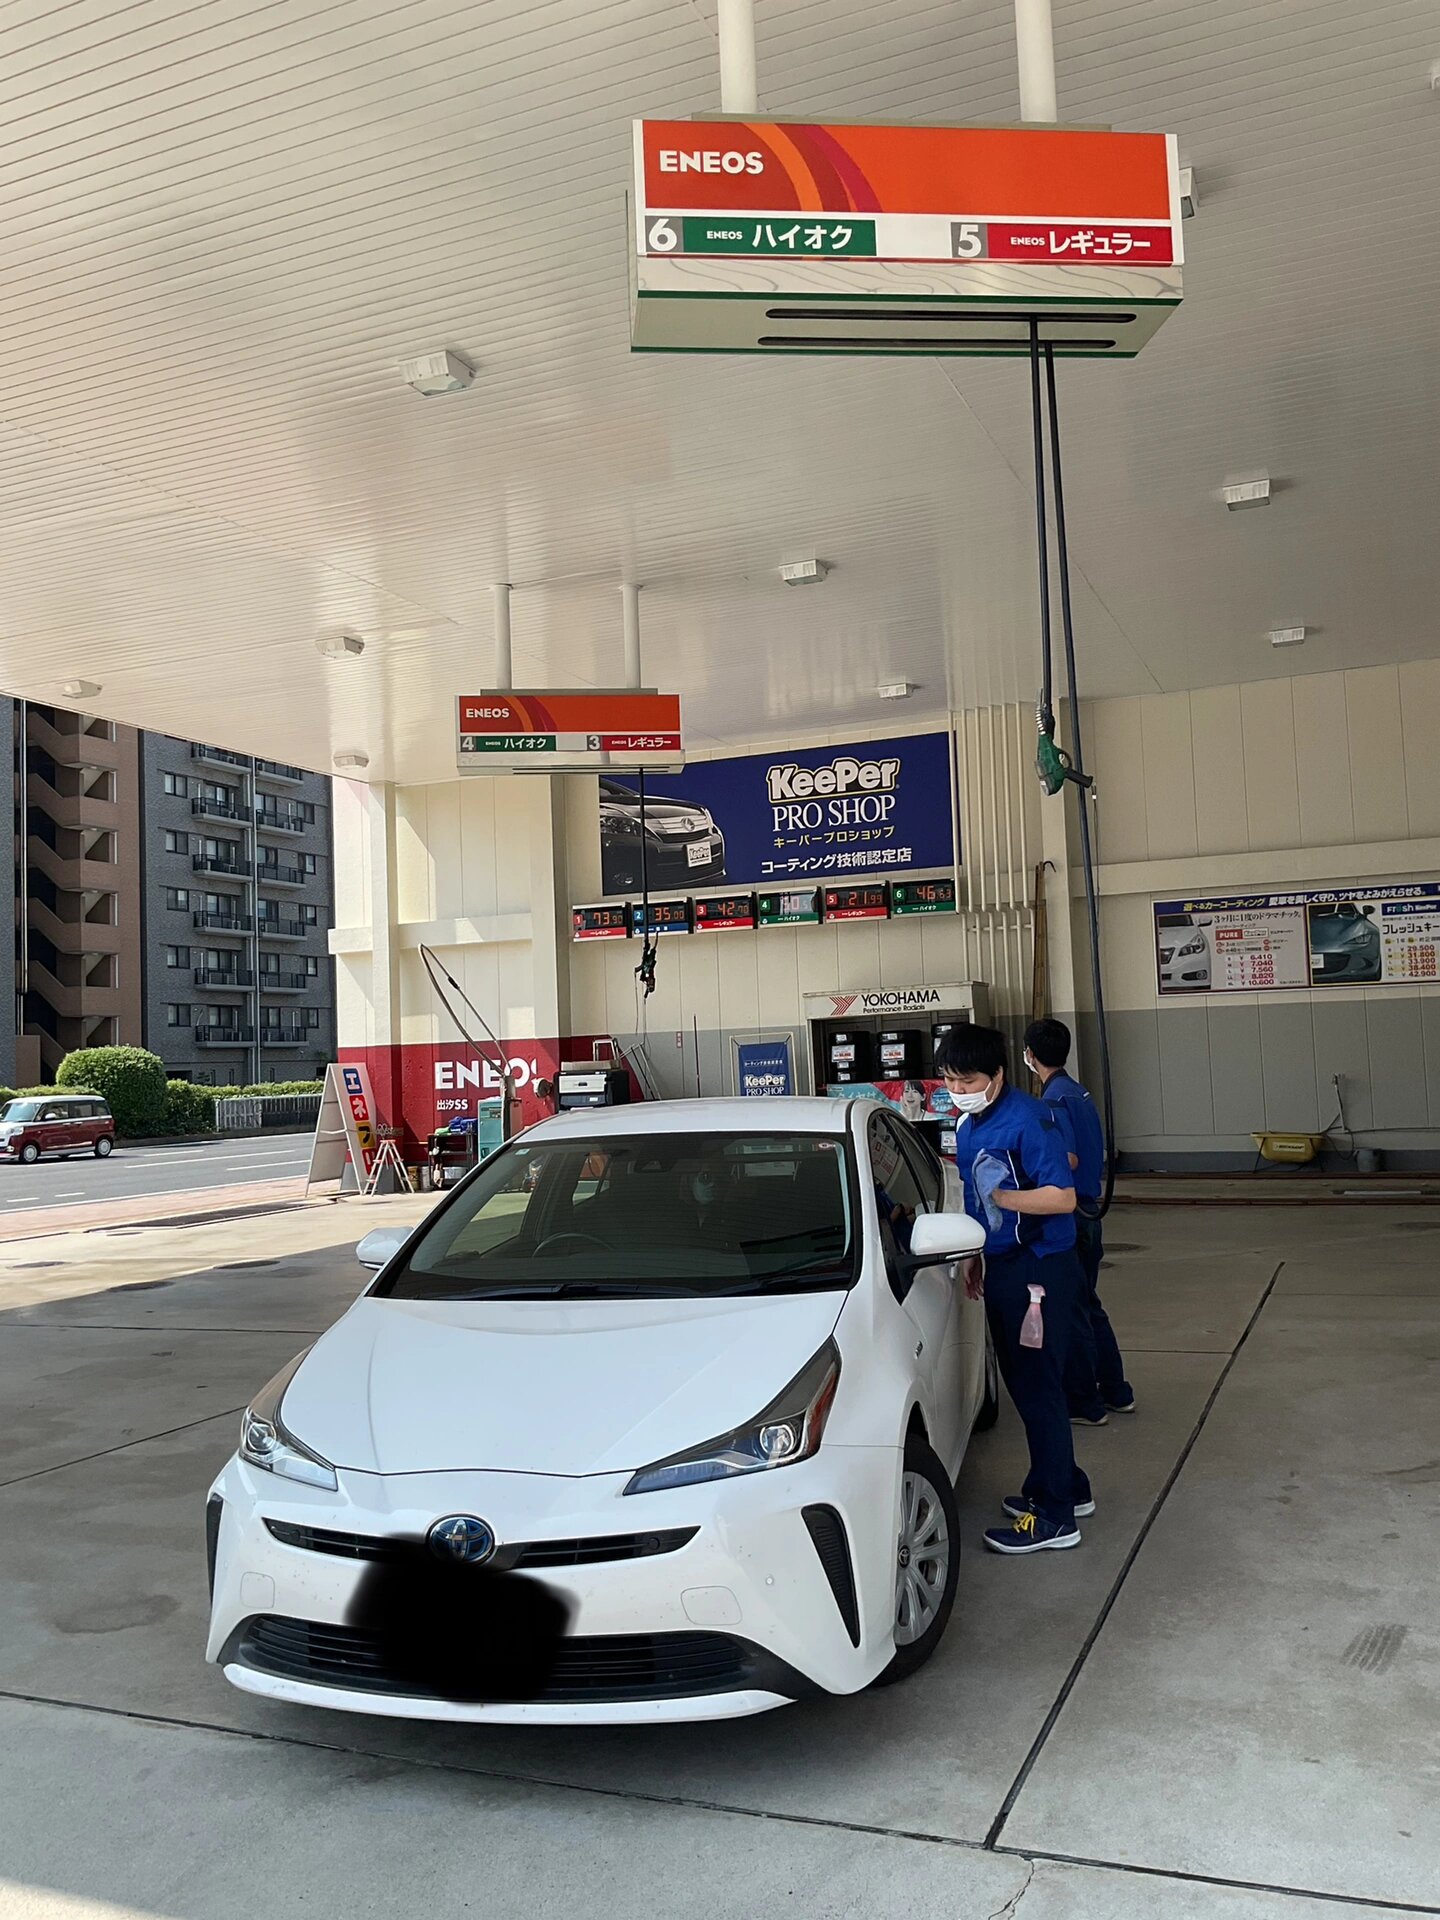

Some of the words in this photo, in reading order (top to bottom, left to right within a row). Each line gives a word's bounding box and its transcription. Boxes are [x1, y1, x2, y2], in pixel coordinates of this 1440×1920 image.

[660, 150, 764, 174] ENEOS
[649, 218, 677, 251] 6
[706, 230, 743, 240] ENEOS
[752, 224, 853, 249] ハイオク
[958, 224, 982, 258] 5
[1010, 236, 1046, 246] ENEOS
[1049, 230, 1151, 255] レギュラー
[466, 708, 510, 718] ENEOS
[462, 736, 474, 750] 4
[504, 737, 547, 749] ハイオク
[589, 735, 600, 750] 3
[628, 736, 672, 748] レギュラー
[768, 759, 898, 801] KeePer
[772, 802, 823, 832] PRO
[828, 795, 896, 826] SHOP
[773, 825, 895, 848] キーパープロショップ
[761, 847, 912, 874] コーティング技術認定店
[830, 895, 834, 903] 5
[896, 890, 902, 898] 6
[636, 911, 641, 919] 2
[699, 906, 704, 914] 3
[1382, 922, 1440, 935] フレッシュキー
[861, 989, 940, 1007] YOKOHAMA
[863, 1005, 902, 1014] Performance
[744, 1074, 785, 1087] KeePer
[746, 1088, 762, 1096] PRO
[763, 1087, 785, 1095] SHOP
[436, 1099, 469, 1111] 出汐SS
